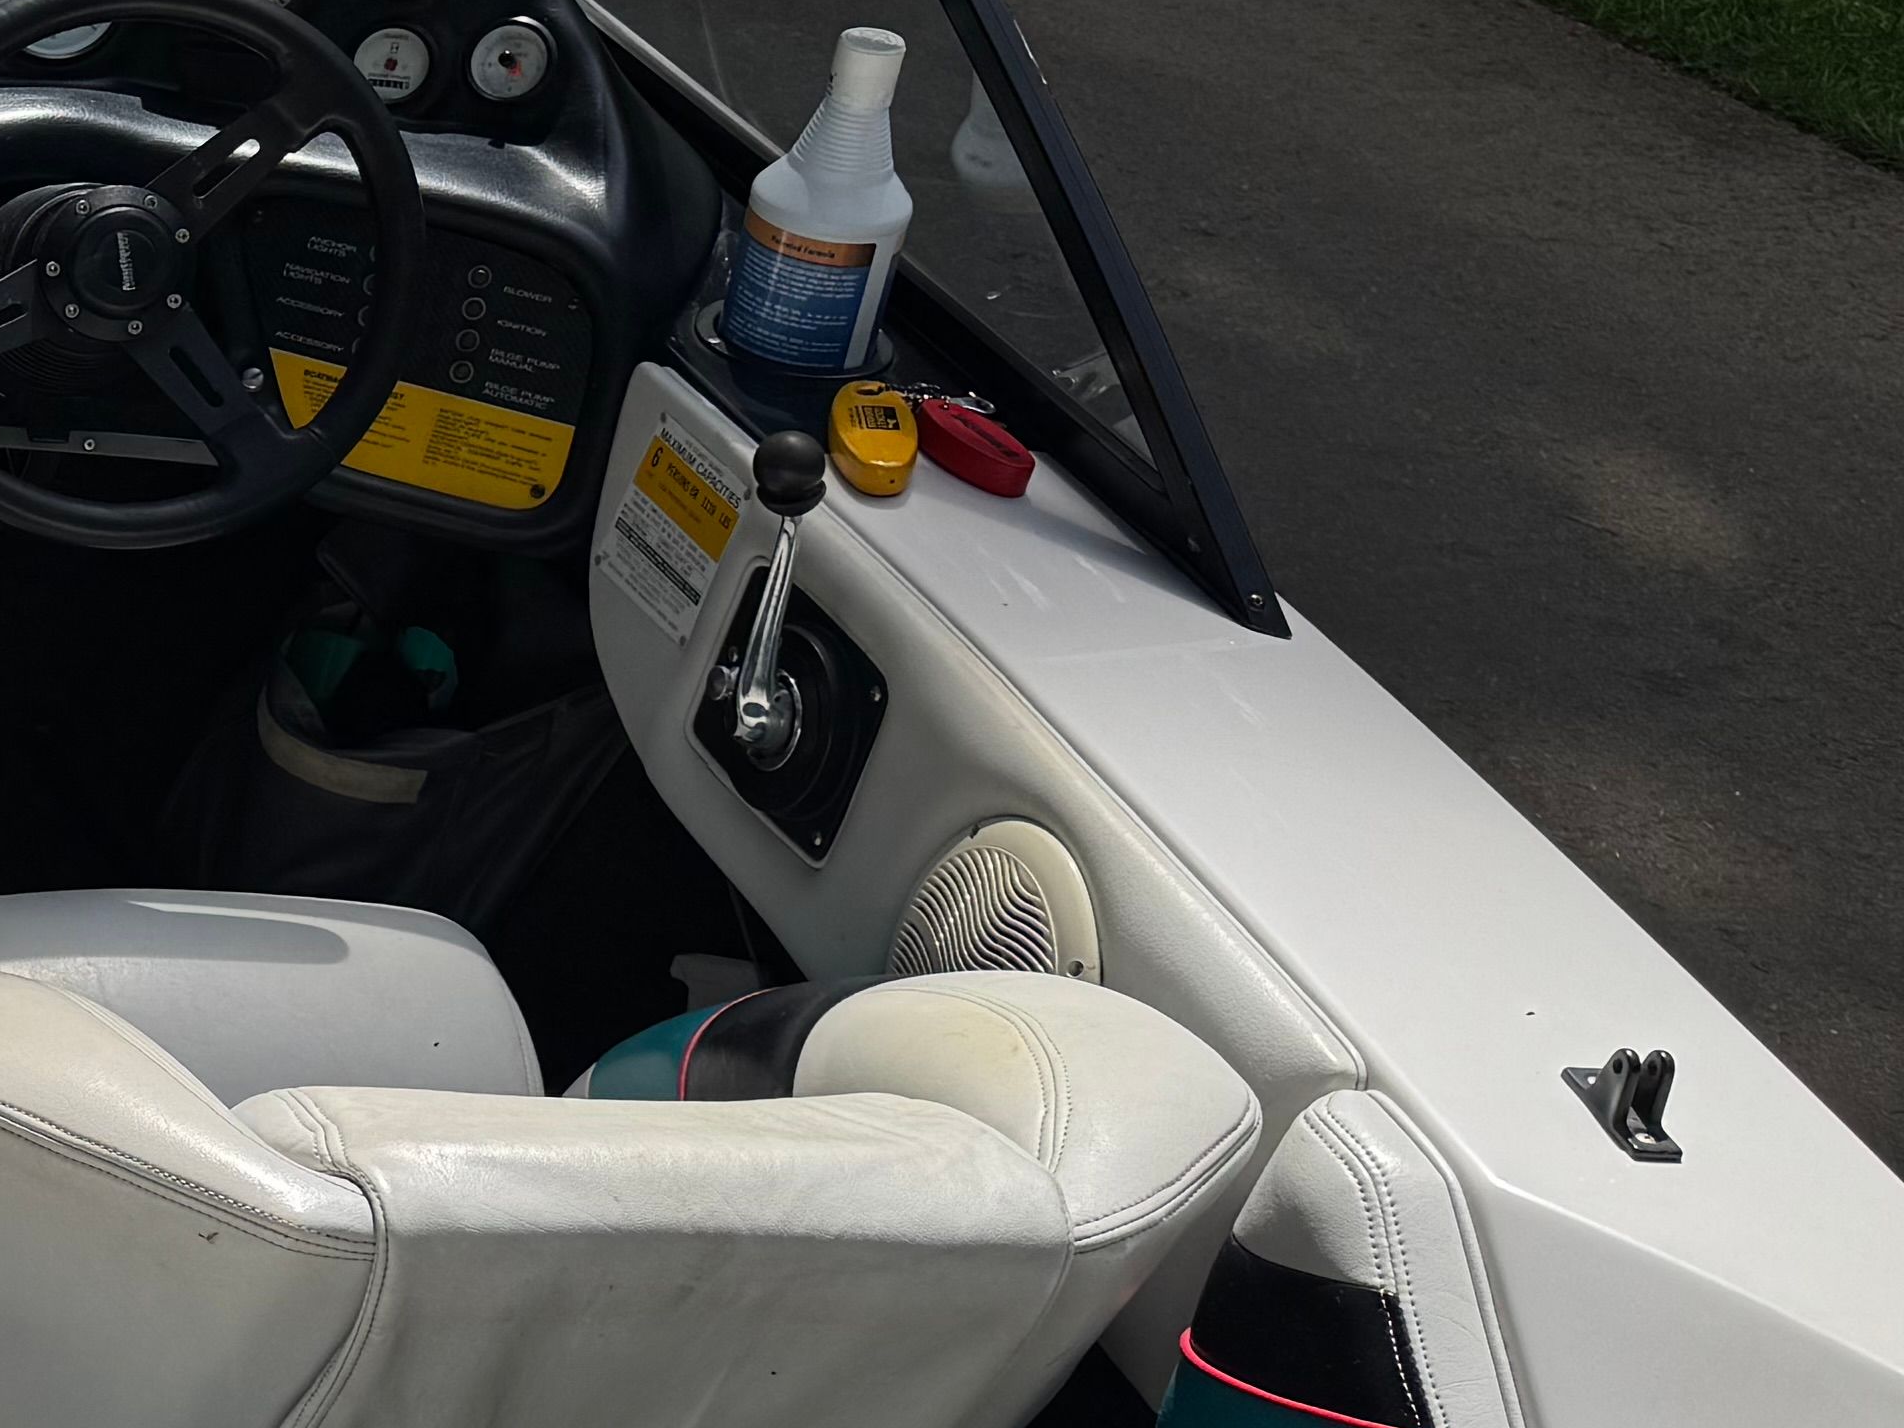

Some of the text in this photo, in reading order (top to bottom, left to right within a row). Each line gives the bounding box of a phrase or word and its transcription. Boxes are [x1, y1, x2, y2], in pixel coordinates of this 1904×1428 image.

[651, 447, 663, 468] 6
[660, 428, 697, 470] MAXIMUM
[696, 462, 742, 509] CAPACITIES
